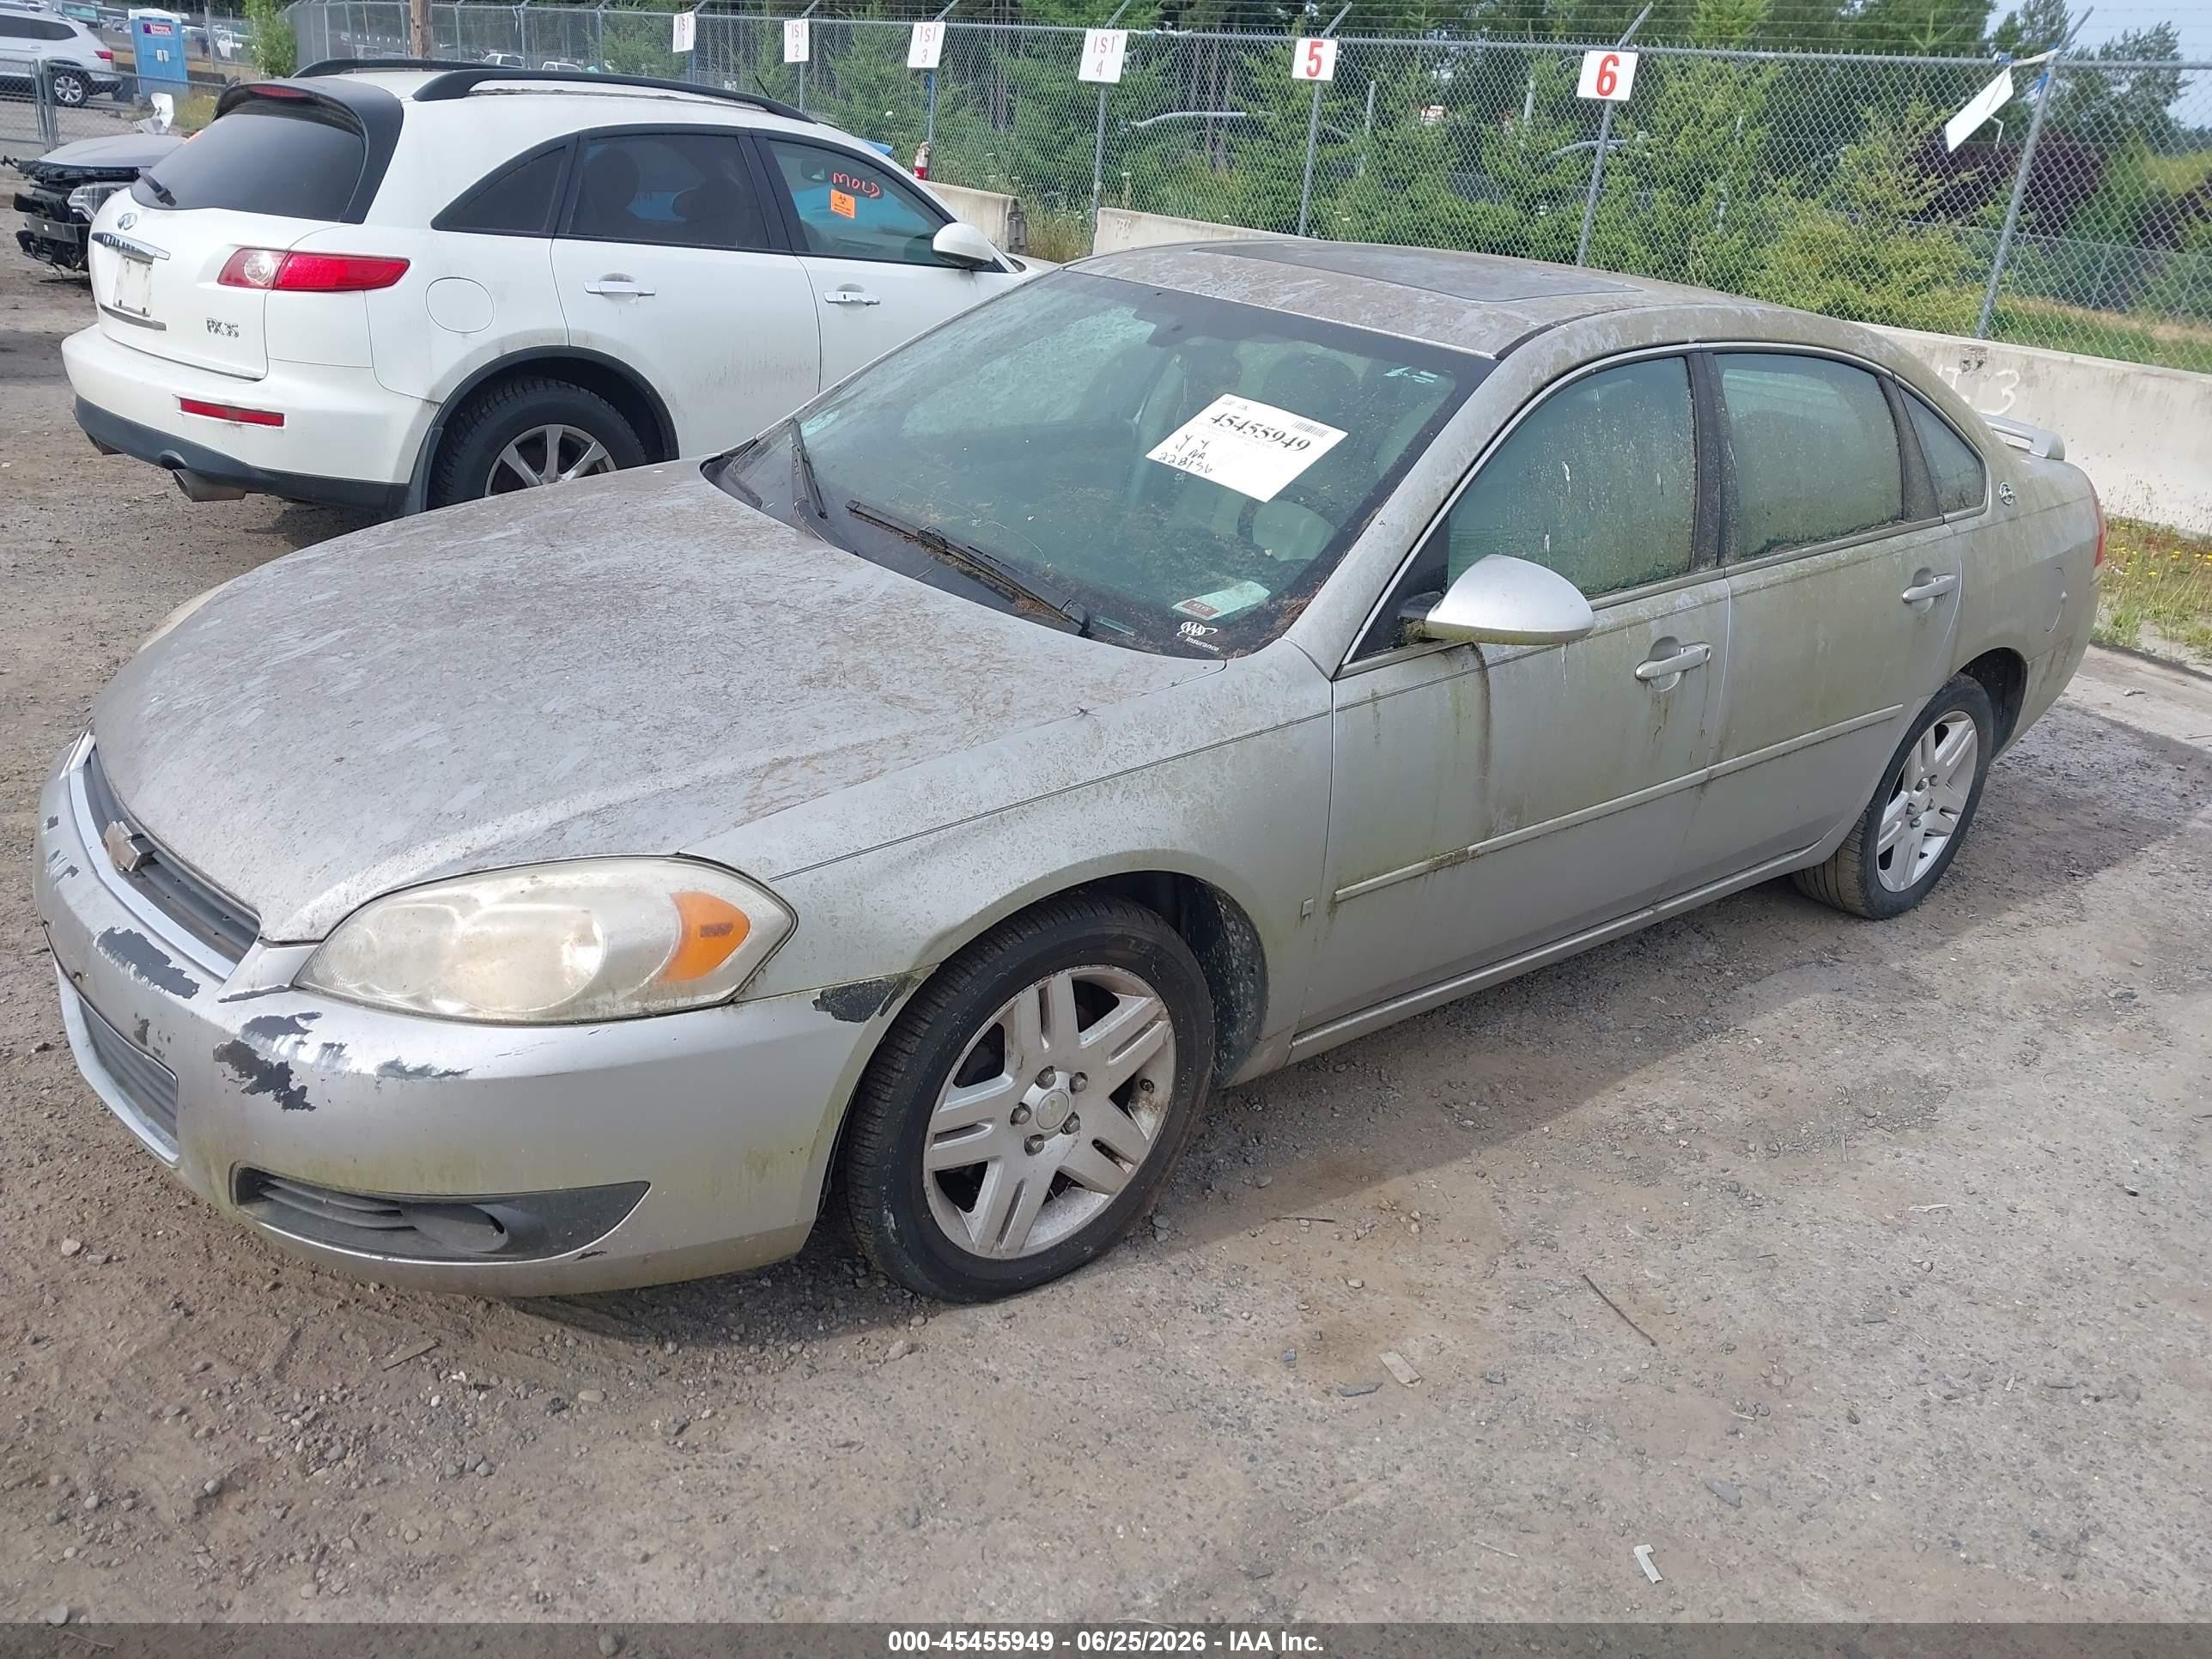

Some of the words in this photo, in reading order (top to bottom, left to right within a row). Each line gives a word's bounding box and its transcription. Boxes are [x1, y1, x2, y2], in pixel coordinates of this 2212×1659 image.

[793, 44, 800, 58] 2
[921, 48, 928, 64] 3
[1306, 40, 1324, 77] 5
[1096, 59, 1104, 76] 4
[1596, 54, 1620, 96] 6
[1210, 413, 1311, 452] 45455949
[1185, 636, 1220, 652] Insurance
